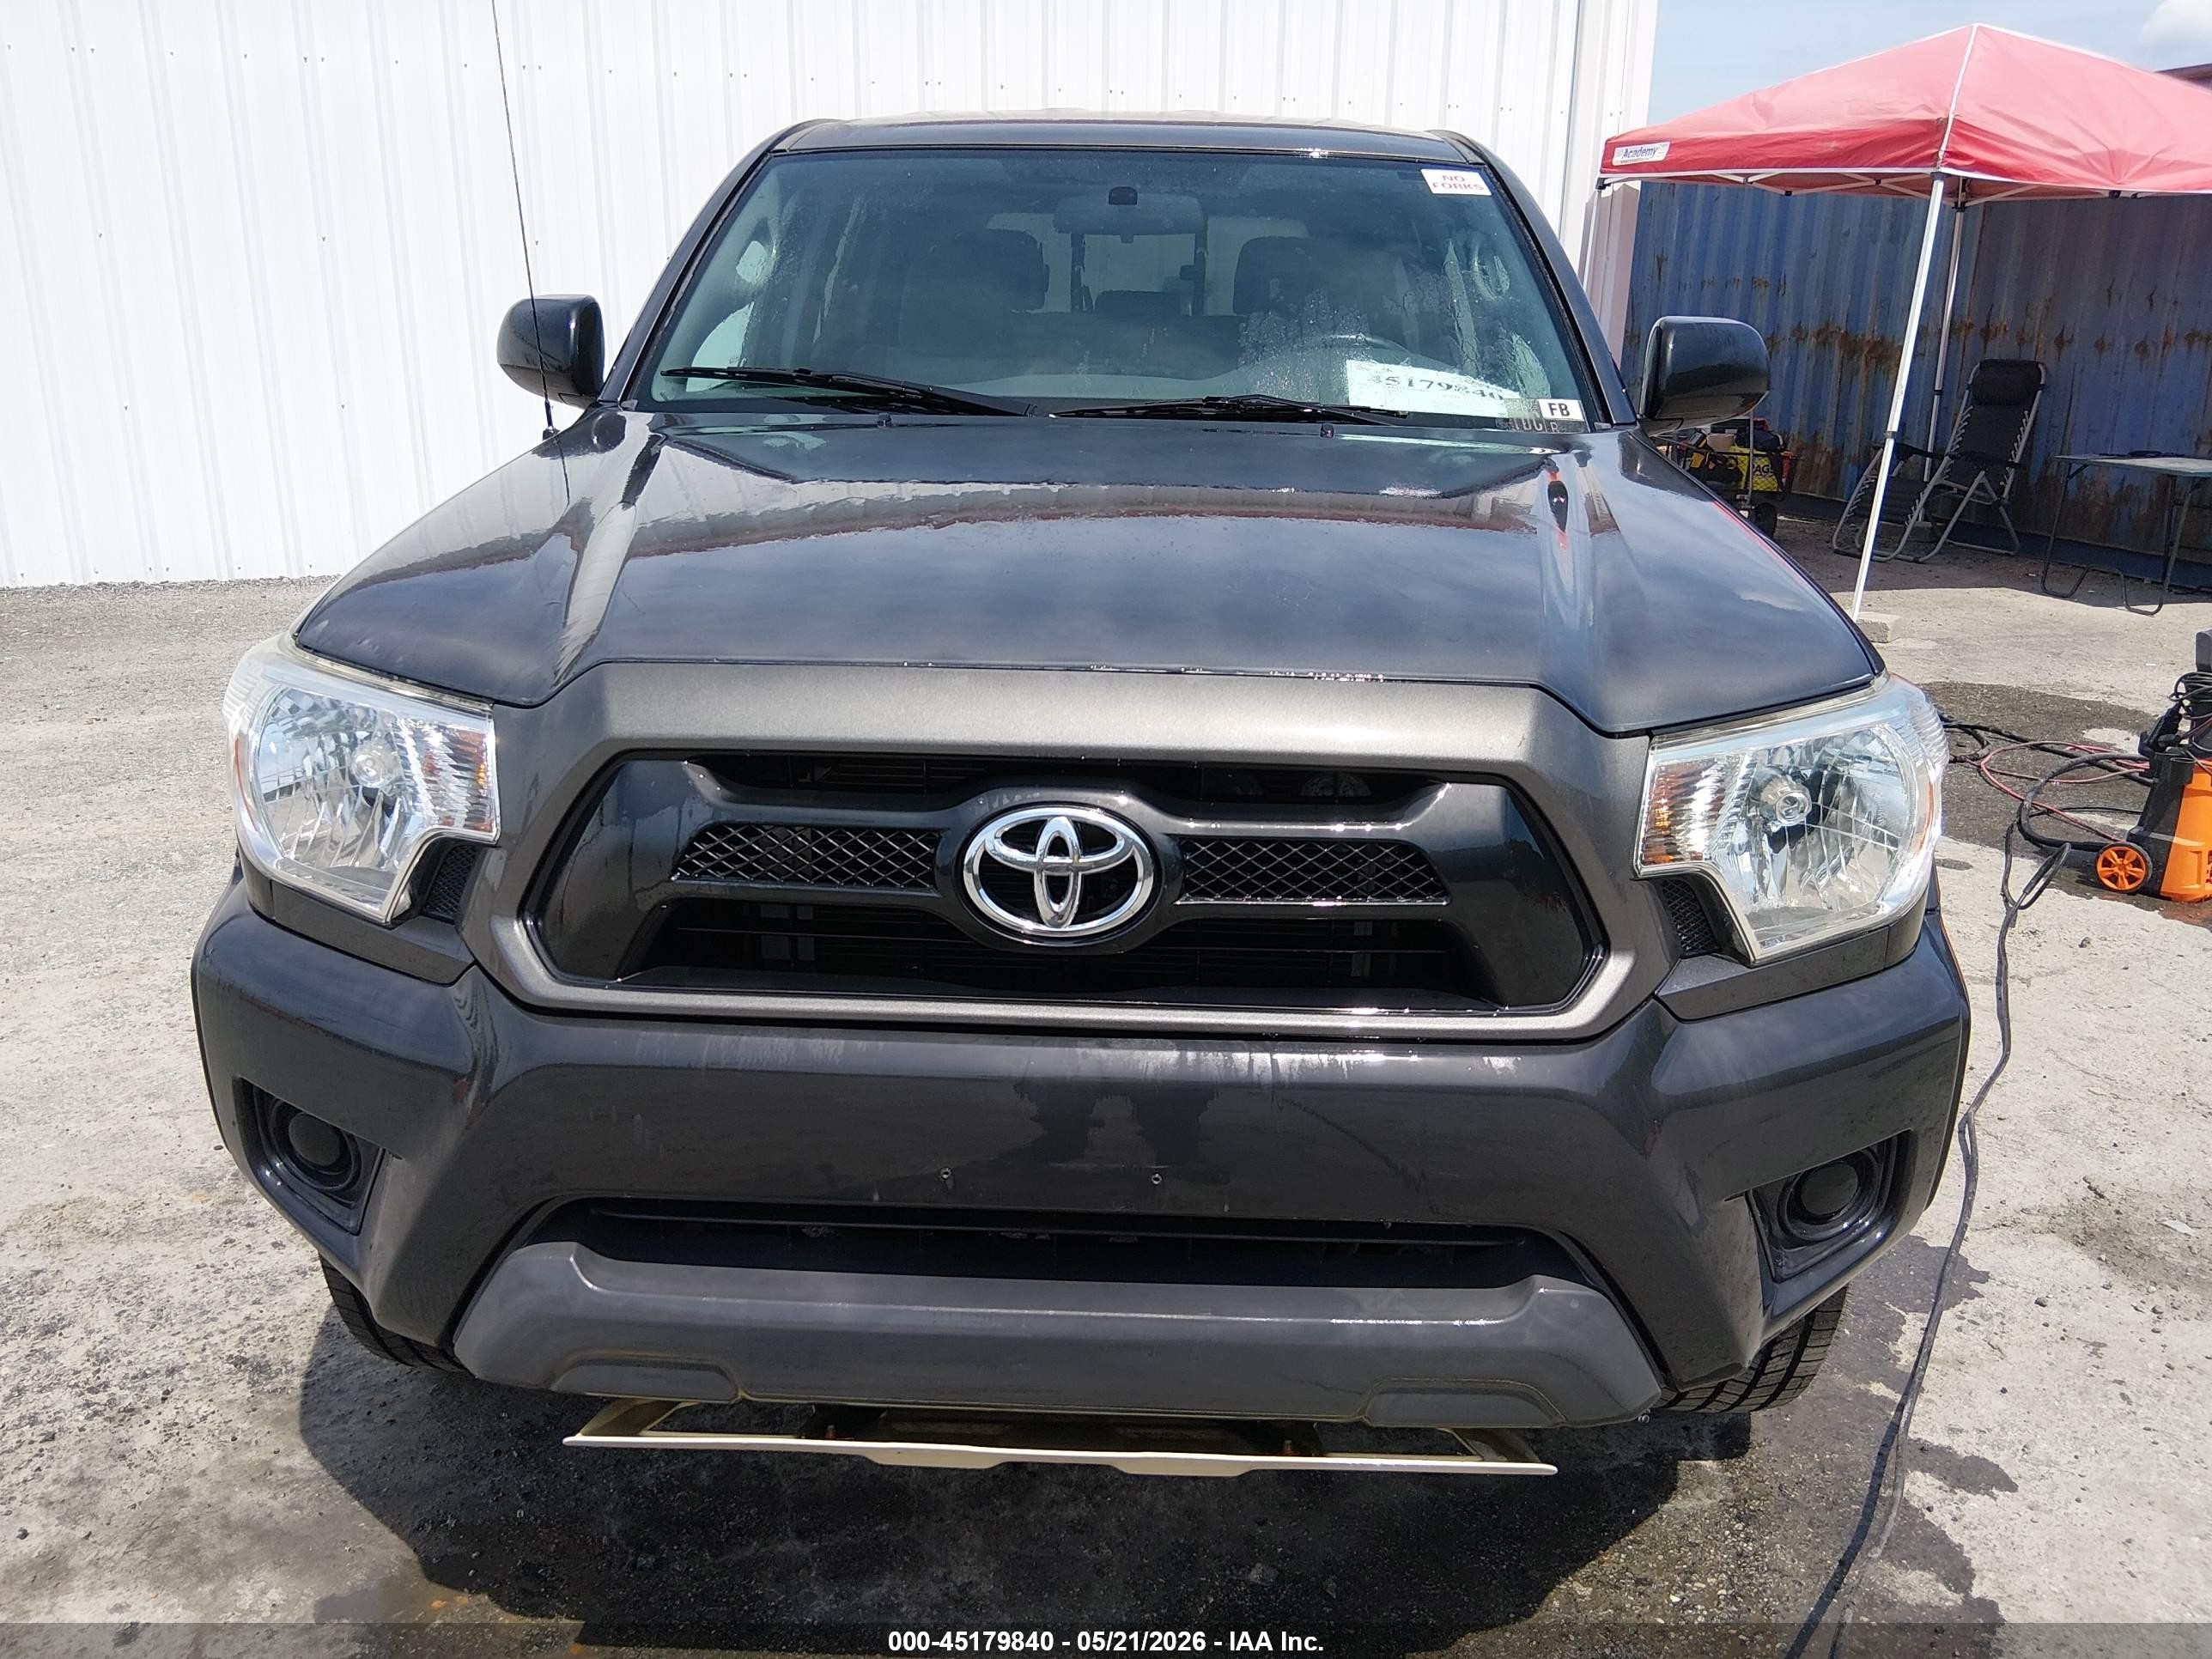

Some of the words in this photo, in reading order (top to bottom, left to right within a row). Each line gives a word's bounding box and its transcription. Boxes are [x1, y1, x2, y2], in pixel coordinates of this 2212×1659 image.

[1621, 147, 1659, 159] Academy
[1432, 182, 1485, 191] FORKS
[1547, 403, 1571, 416] FB
